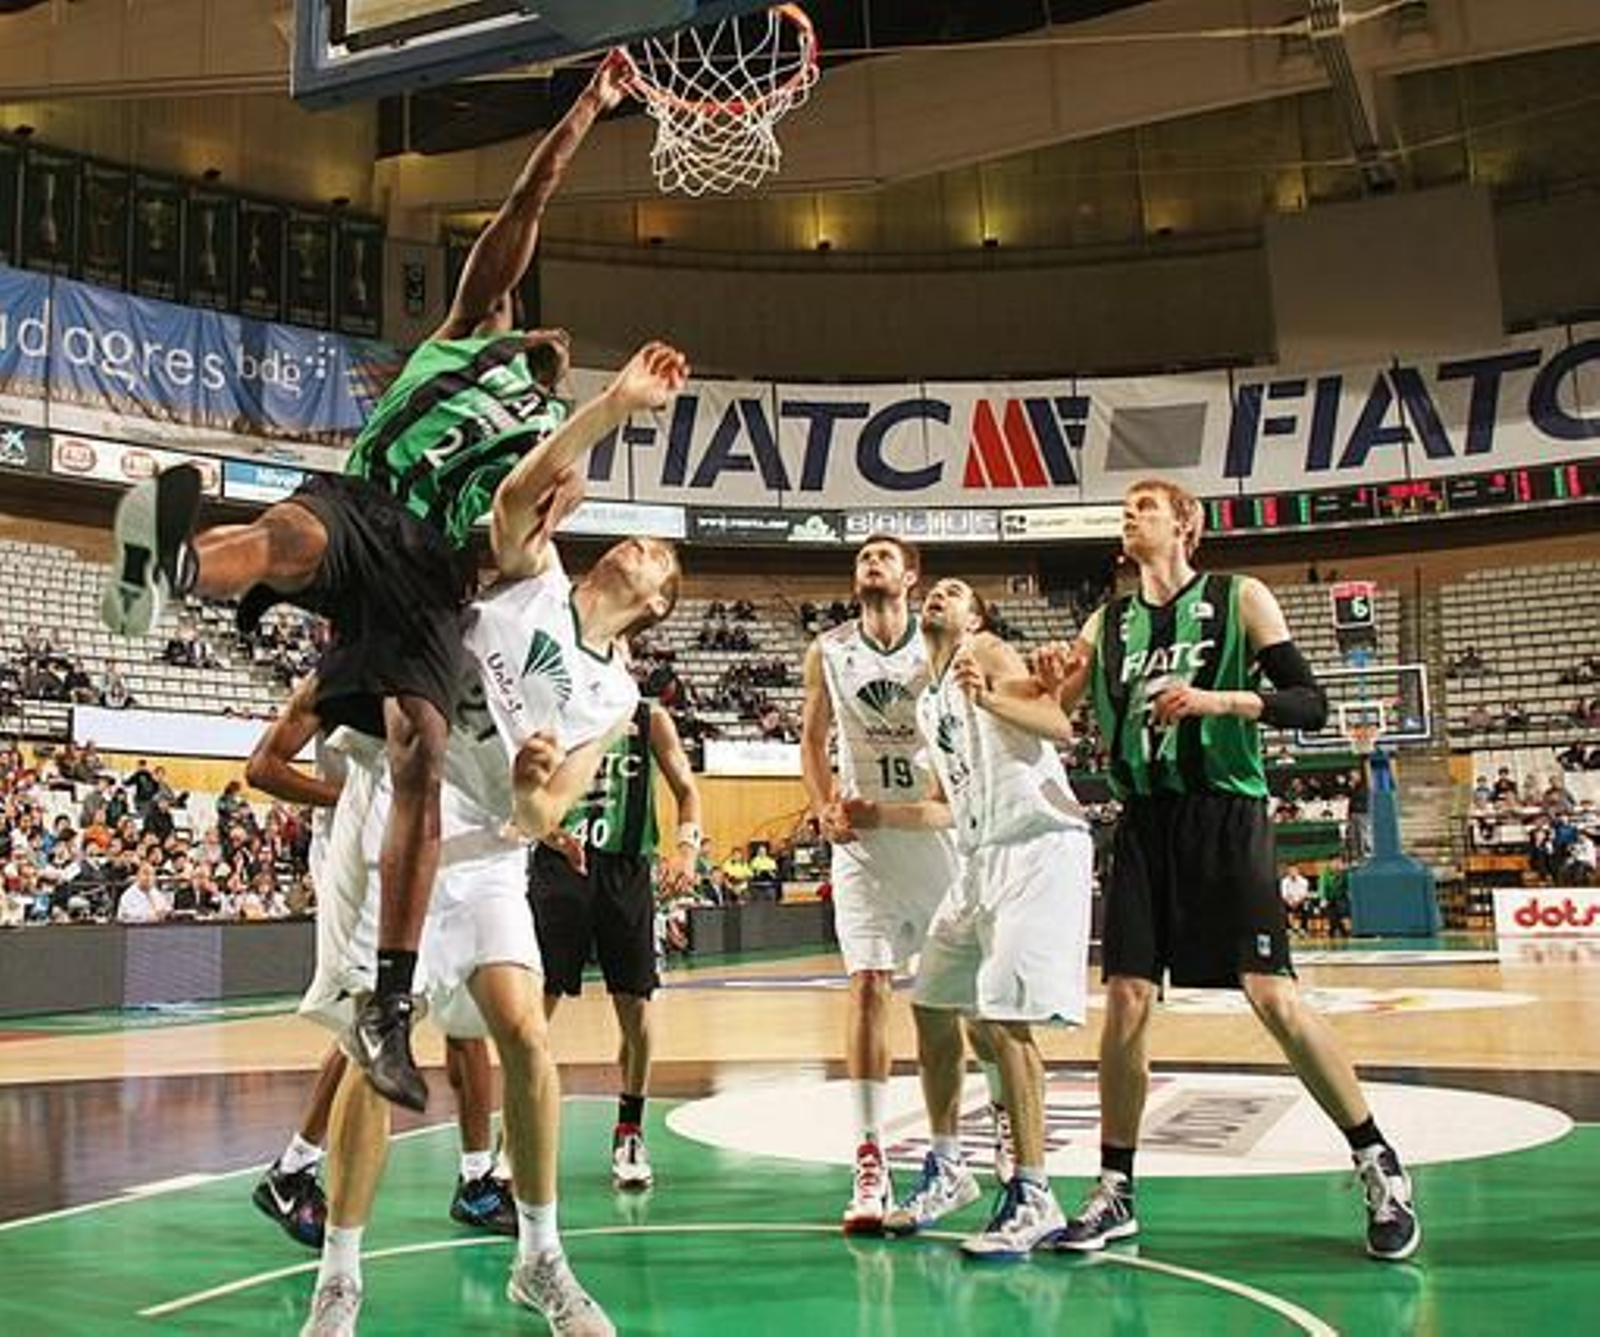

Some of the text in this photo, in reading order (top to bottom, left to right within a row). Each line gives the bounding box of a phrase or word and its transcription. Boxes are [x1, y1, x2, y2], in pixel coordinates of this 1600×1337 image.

[1223, 339, 1600, 478] FIATC
[1352, 596, 1368, 618] 6
[1122, 640, 1215, 682] FIATC
[876, 756, 914, 788] 19
[571, 819, 609, 848] 40
